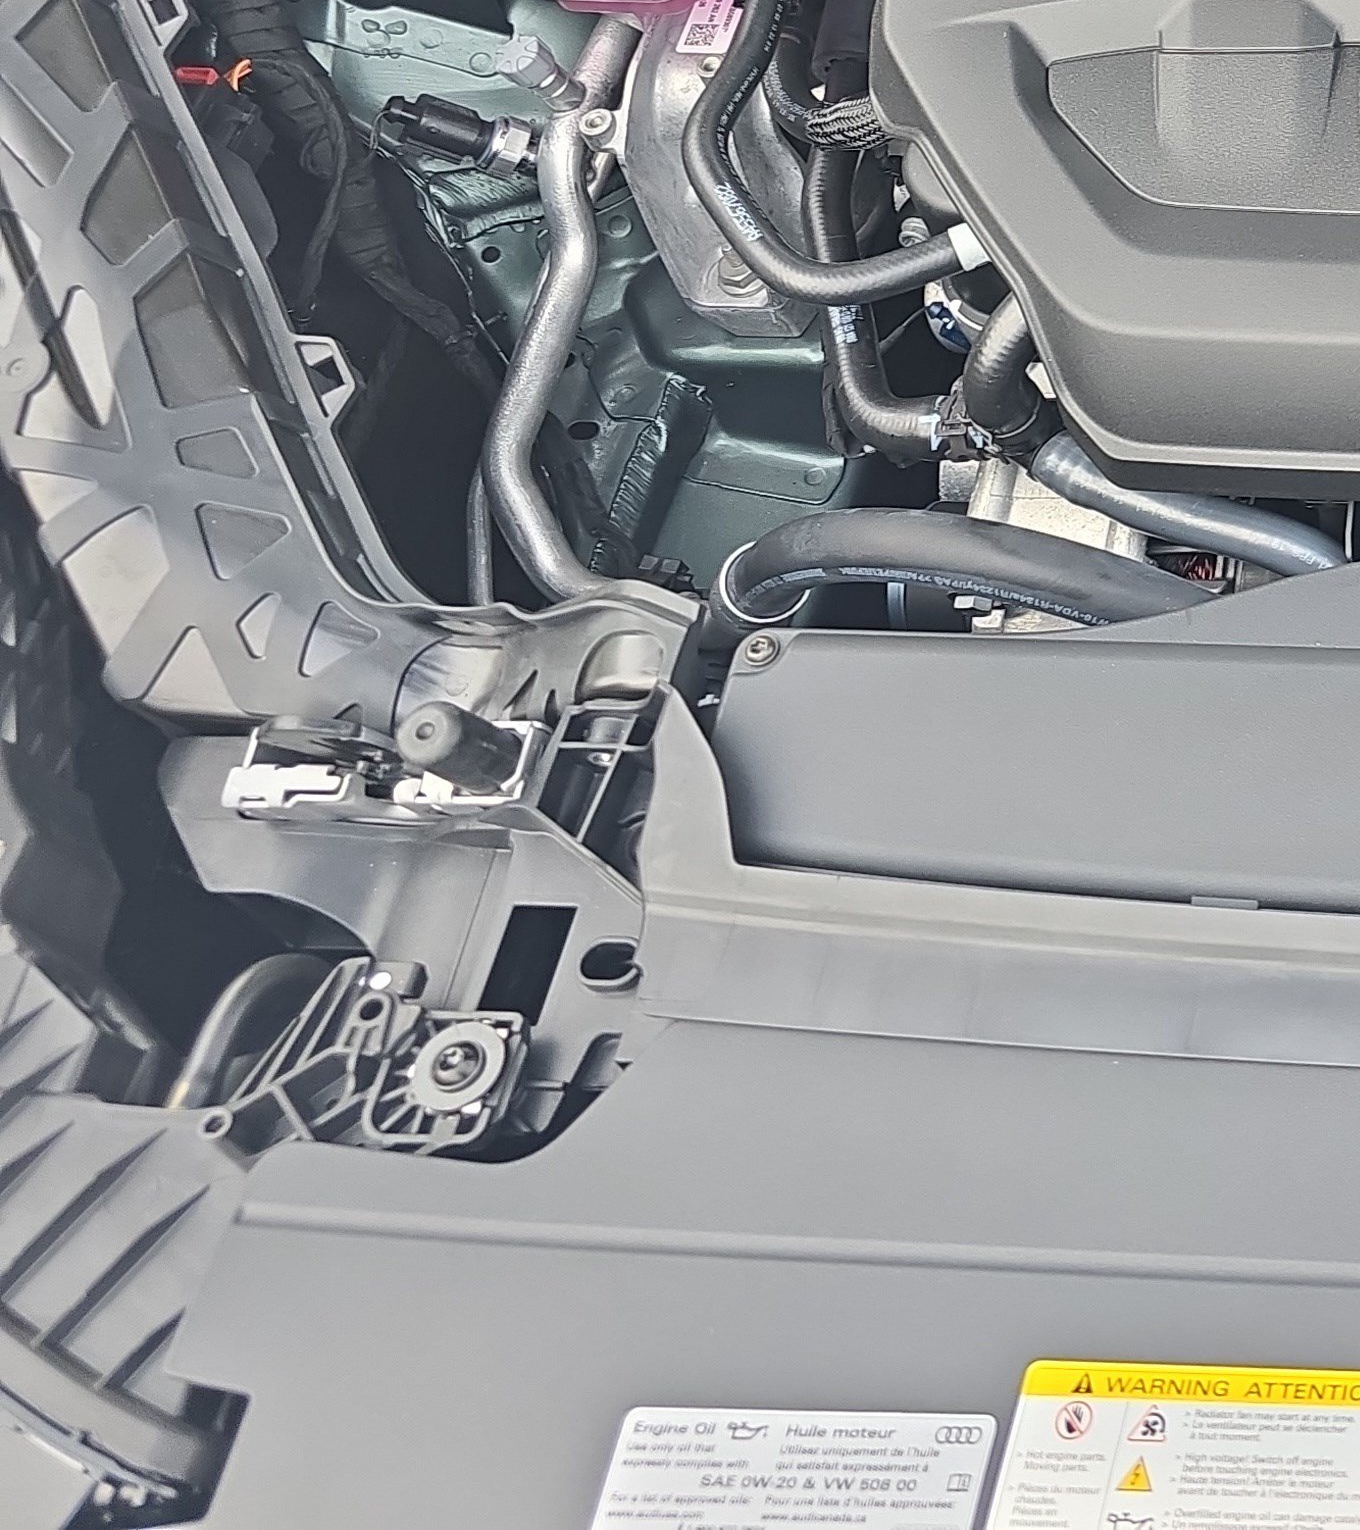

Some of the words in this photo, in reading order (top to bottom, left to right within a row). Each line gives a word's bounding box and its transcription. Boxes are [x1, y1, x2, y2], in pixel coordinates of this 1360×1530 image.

[1107, 1376, 1230, 1398] WARNING
[1195, 1409, 1234, 1419] Radiator
[1237, 1410, 1252, 1420] fan
[1255, 1412, 1275, 1422] may
[1277, 1412, 1299, 1422] start
[1313, 1414, 1333, 1424] any
[633, 1421, 689, 1437] Engine
[694, 1422, 717, 1436] Oil
[786, 1423, 828, 1439] Huile
[831, 1426, 897, 1440] moteur
[1206, 1422, 1256, 1432] ventilateur
[1258, 1423, 1280, 1434] peut
[821, 1447, 887, 1458] uniquement
[1026, 1451, 1045, 1460] Hot
[1047, 1452, 1078, 1463] engine
[775, 1462, 793, 1471] qui
[1024, 1461, 1060, 1473] Moving
[1185, 1453, 1207, 1465] High
[1210, 1454, 1249, 1466] voltage!
[1251, 1454, 1283, 1465] Switch
[1286, 1455, 1299, 1465] off
[1301, 1457, 1334, 1468] engine
[1182, 1464, 1214, 1474] before
[1216, 1465, 1258, 1477] touching
[1261, 1467, 1292, 1478] engine
[1295, 1467, 1349, 1478] electronics.
[700, 1474, 737, 1488] SAE
[802, 1476, 816, 1489] &
[824, 1477, 855, 1491] VW
[859, 1478, 891, 1491] 508
[896, 1479, 917, 1492] 00
[1180, 1474, 1208, 1485] Haute
[1299, 1479, 1335, 1489] moteur
[1051, 1485, 1063, 1494] du
[1065, 1486, 1100, 1495] moteur
[1177, 1487, 1204, 1497] avant
[1206, 1487, 1218, 1497] de
[1221, 1488, 1258, 1498] toucher
[1336, 1491, 1349, 1501] du
[1044, 1508, 1057, 1516] en
[1174, 1508, 1221, 1520] Overfilled
[1223, 1511, 1255, 1523] engine
[1257, 1512, 1271, 1521] oil
[1273, 1513, 1291, 1522] can
[1294, 1512, 1332, 1524] damage
